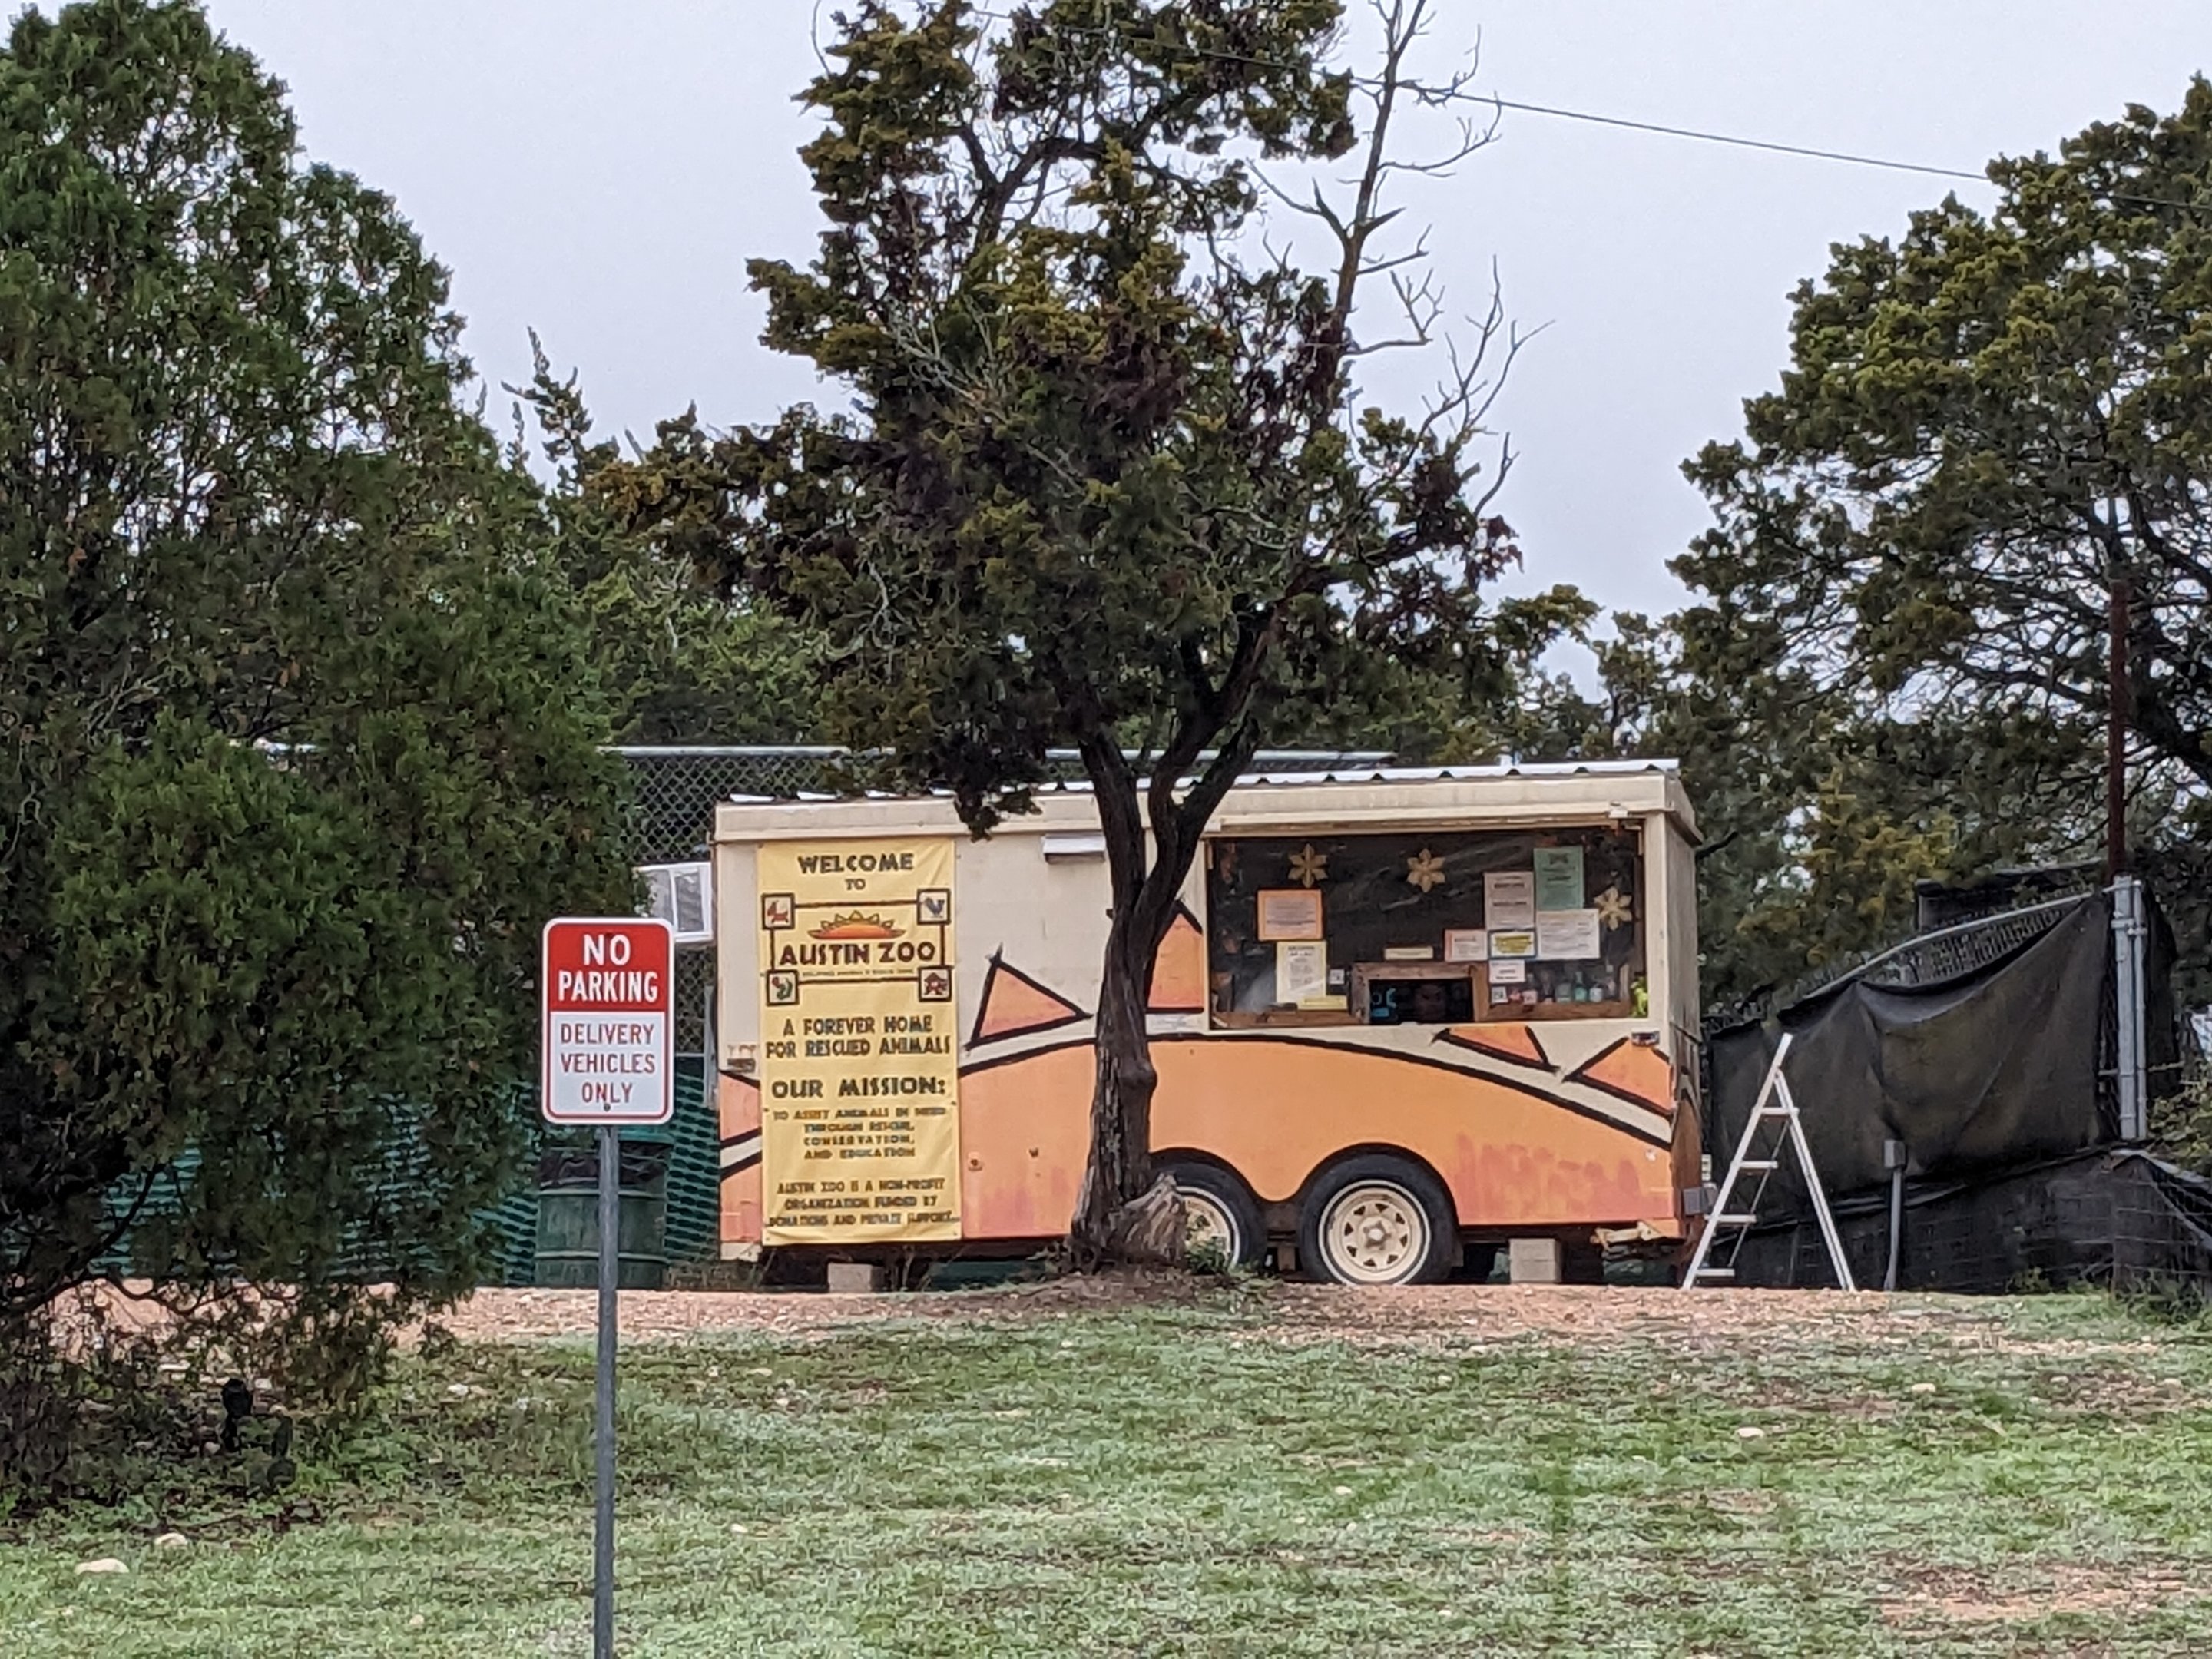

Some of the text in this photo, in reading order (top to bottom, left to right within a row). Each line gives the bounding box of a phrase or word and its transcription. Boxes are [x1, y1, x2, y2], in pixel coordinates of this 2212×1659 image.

[798, 853, 914, 874] WELCOME
[845, 879, 866, 891] TO
[584, 934, 631, 965] NO
[779, 942, 935, 965] AUSTIN ZOO
[558, 970, 658, 1002] PARKING
[561, 1024, 654, 1045] DELIVERY
[783, 1015, 932, 1036] A FOREVER HOME
[767, 1035, 950, 1058] FOR RESCUED ANIMALS
[561, 1053, 655, 1073] VEHICLES
[581, 1082, 632, 1103] ONLY
[772, 1076, 946, 1098] OUR MISSION:
[773, 1111, 789, 1121] TO
[836, 1108, 889, 1119] ANIMALS
[896, 1108, 909, 1118] IN
[804, 1123, 863, 1133] THROUGH
[804, 1147, 915, 1160] AND EDUCATION
[777, 1181, 815, 1194] AUSTIN
[820, 1181, 845, 1193] ZOO
[850, 1181, 859, 1192] IS
[865, 1180, 873, 1192] A
[784, 1197, 869, 1210] ORGANIZATION
